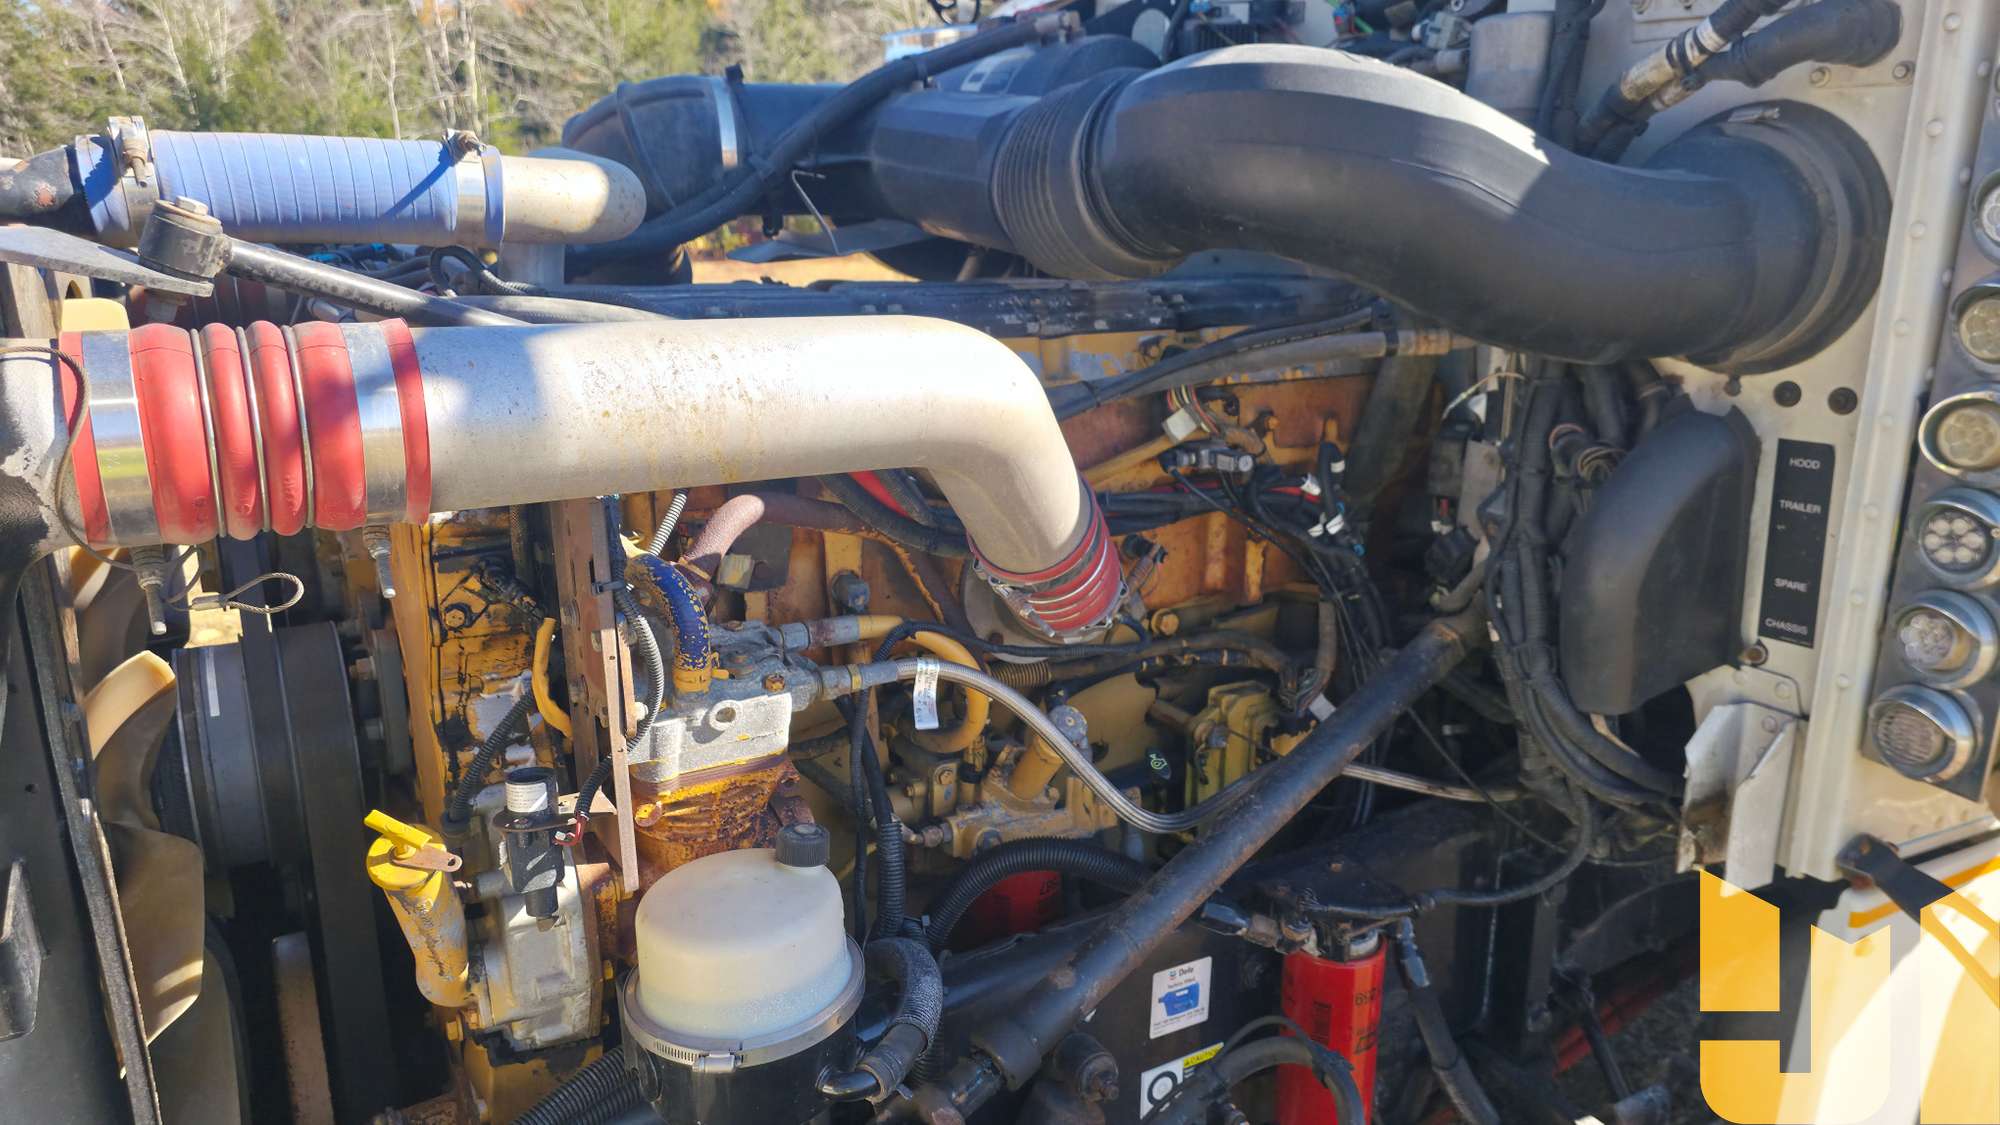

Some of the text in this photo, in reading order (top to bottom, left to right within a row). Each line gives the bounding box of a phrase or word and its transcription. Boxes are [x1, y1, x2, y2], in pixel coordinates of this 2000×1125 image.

[1789, 457, 1821, 470] HOOD
[1779, 499, 1822, 514] TRAILER
[1774, 577, 1808, 593] SPARE
[1764, 617, 1808, 636] CHASSIS
